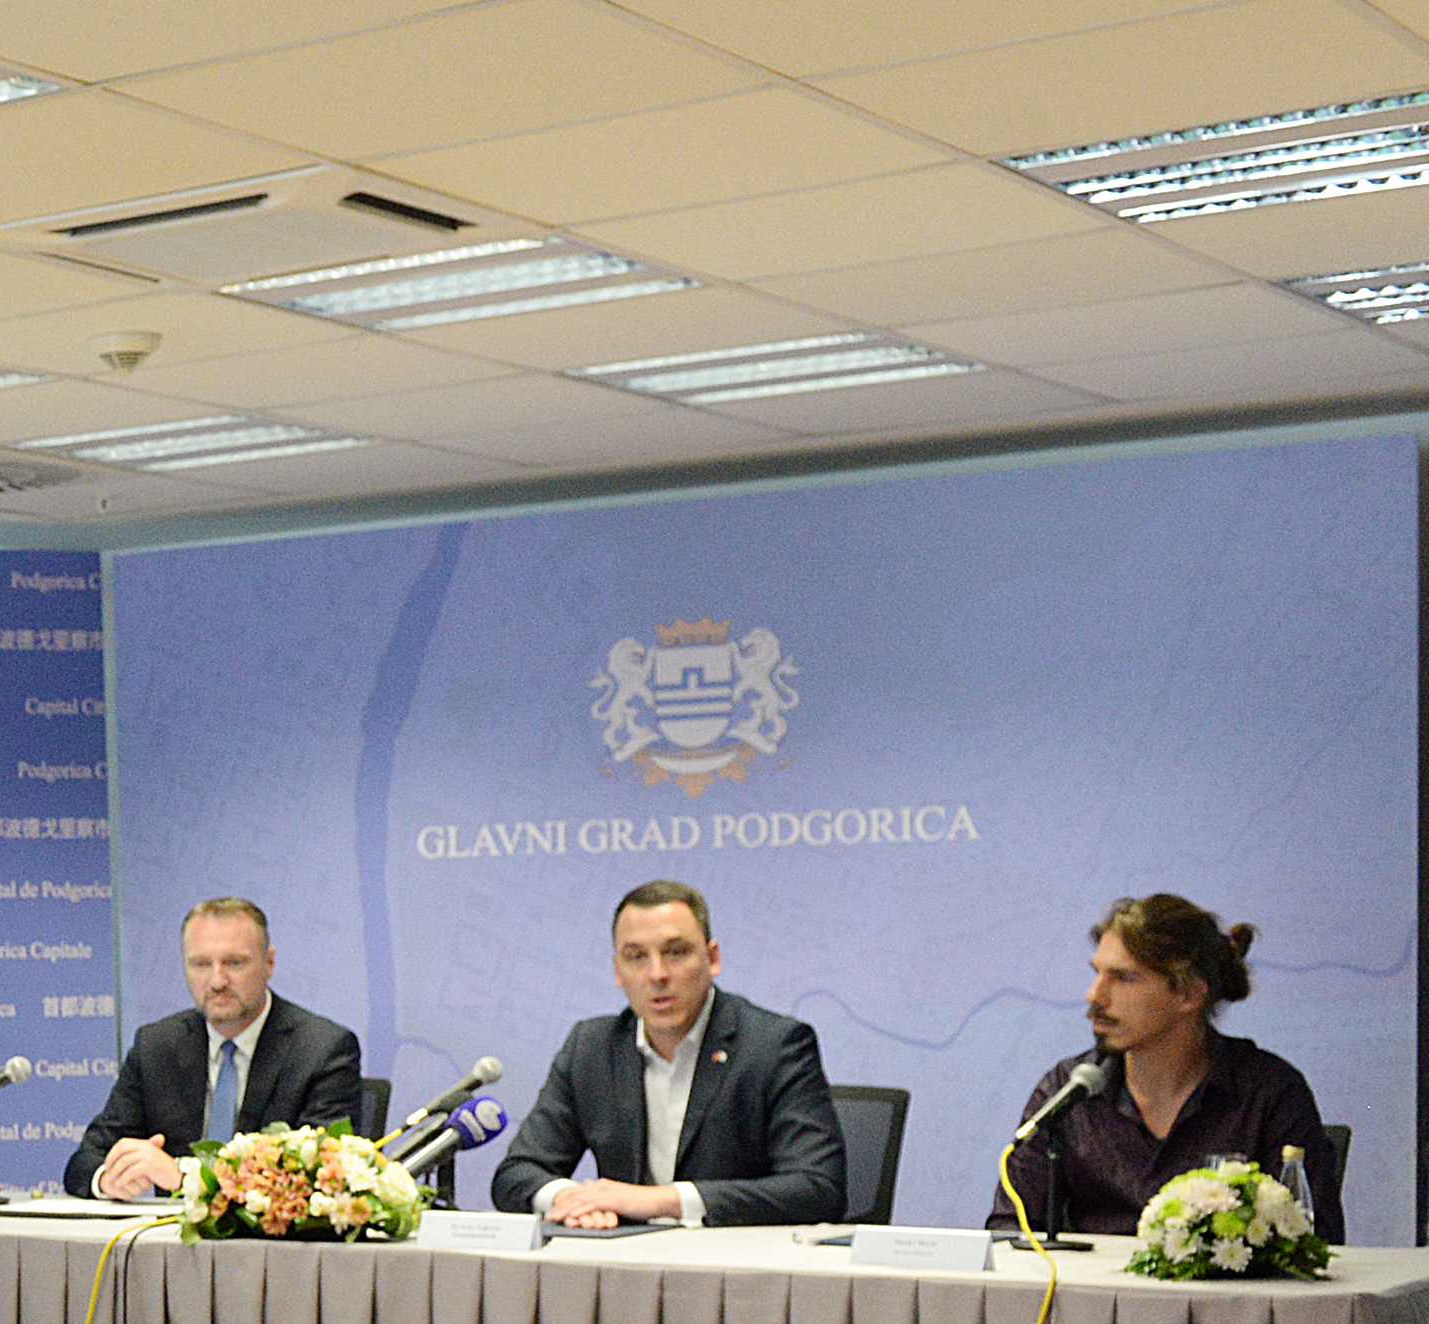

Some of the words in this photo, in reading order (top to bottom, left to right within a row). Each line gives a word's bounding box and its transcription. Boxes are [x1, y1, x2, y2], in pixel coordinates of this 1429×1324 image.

[11, 571, 86, 592] Podgorica
[25, 698, 79, 720] Capital
[18, 761, 91, 782] Podgorica
[416, 822, 567, 860] GLAVNI
[577, 815, 702, 853] GRAD
[713, 804, 981, 849] PODGORICA
[19, 881, 39, 898] de
[30, 942, 92, 962] Capitale
[35, 1059, 89, 1080] Capital
[93, 1058, 119, 1076] Cit
[23, 1122, 40, 1140] de
